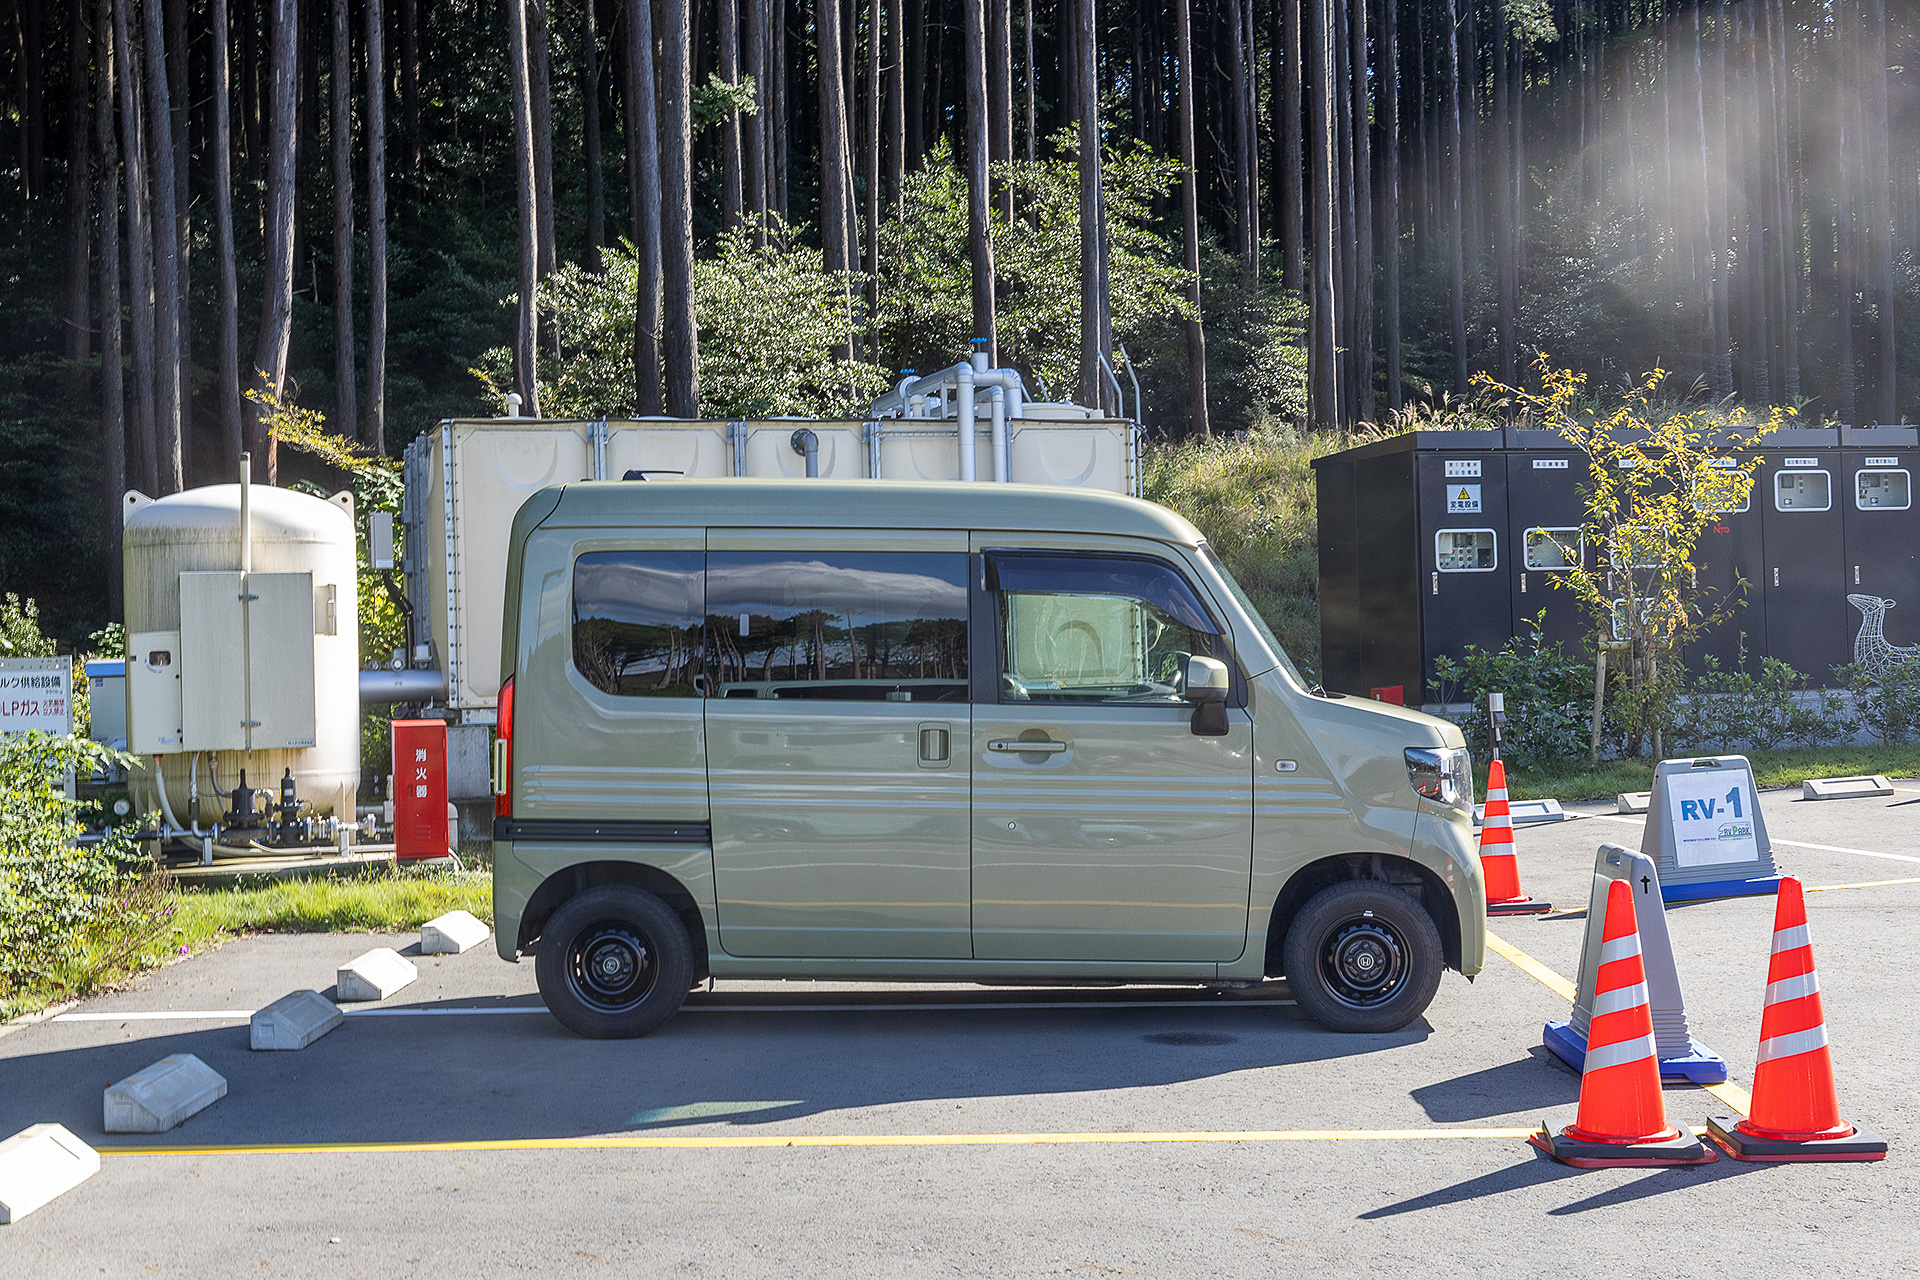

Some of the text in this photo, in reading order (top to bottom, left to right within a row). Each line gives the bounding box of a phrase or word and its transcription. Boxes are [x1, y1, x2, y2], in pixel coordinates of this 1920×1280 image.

[2, 699, 40, 717] LPガス
[415, 748, 427, 799] 消火器
[1680, 786, 1743, 821] RV-1
